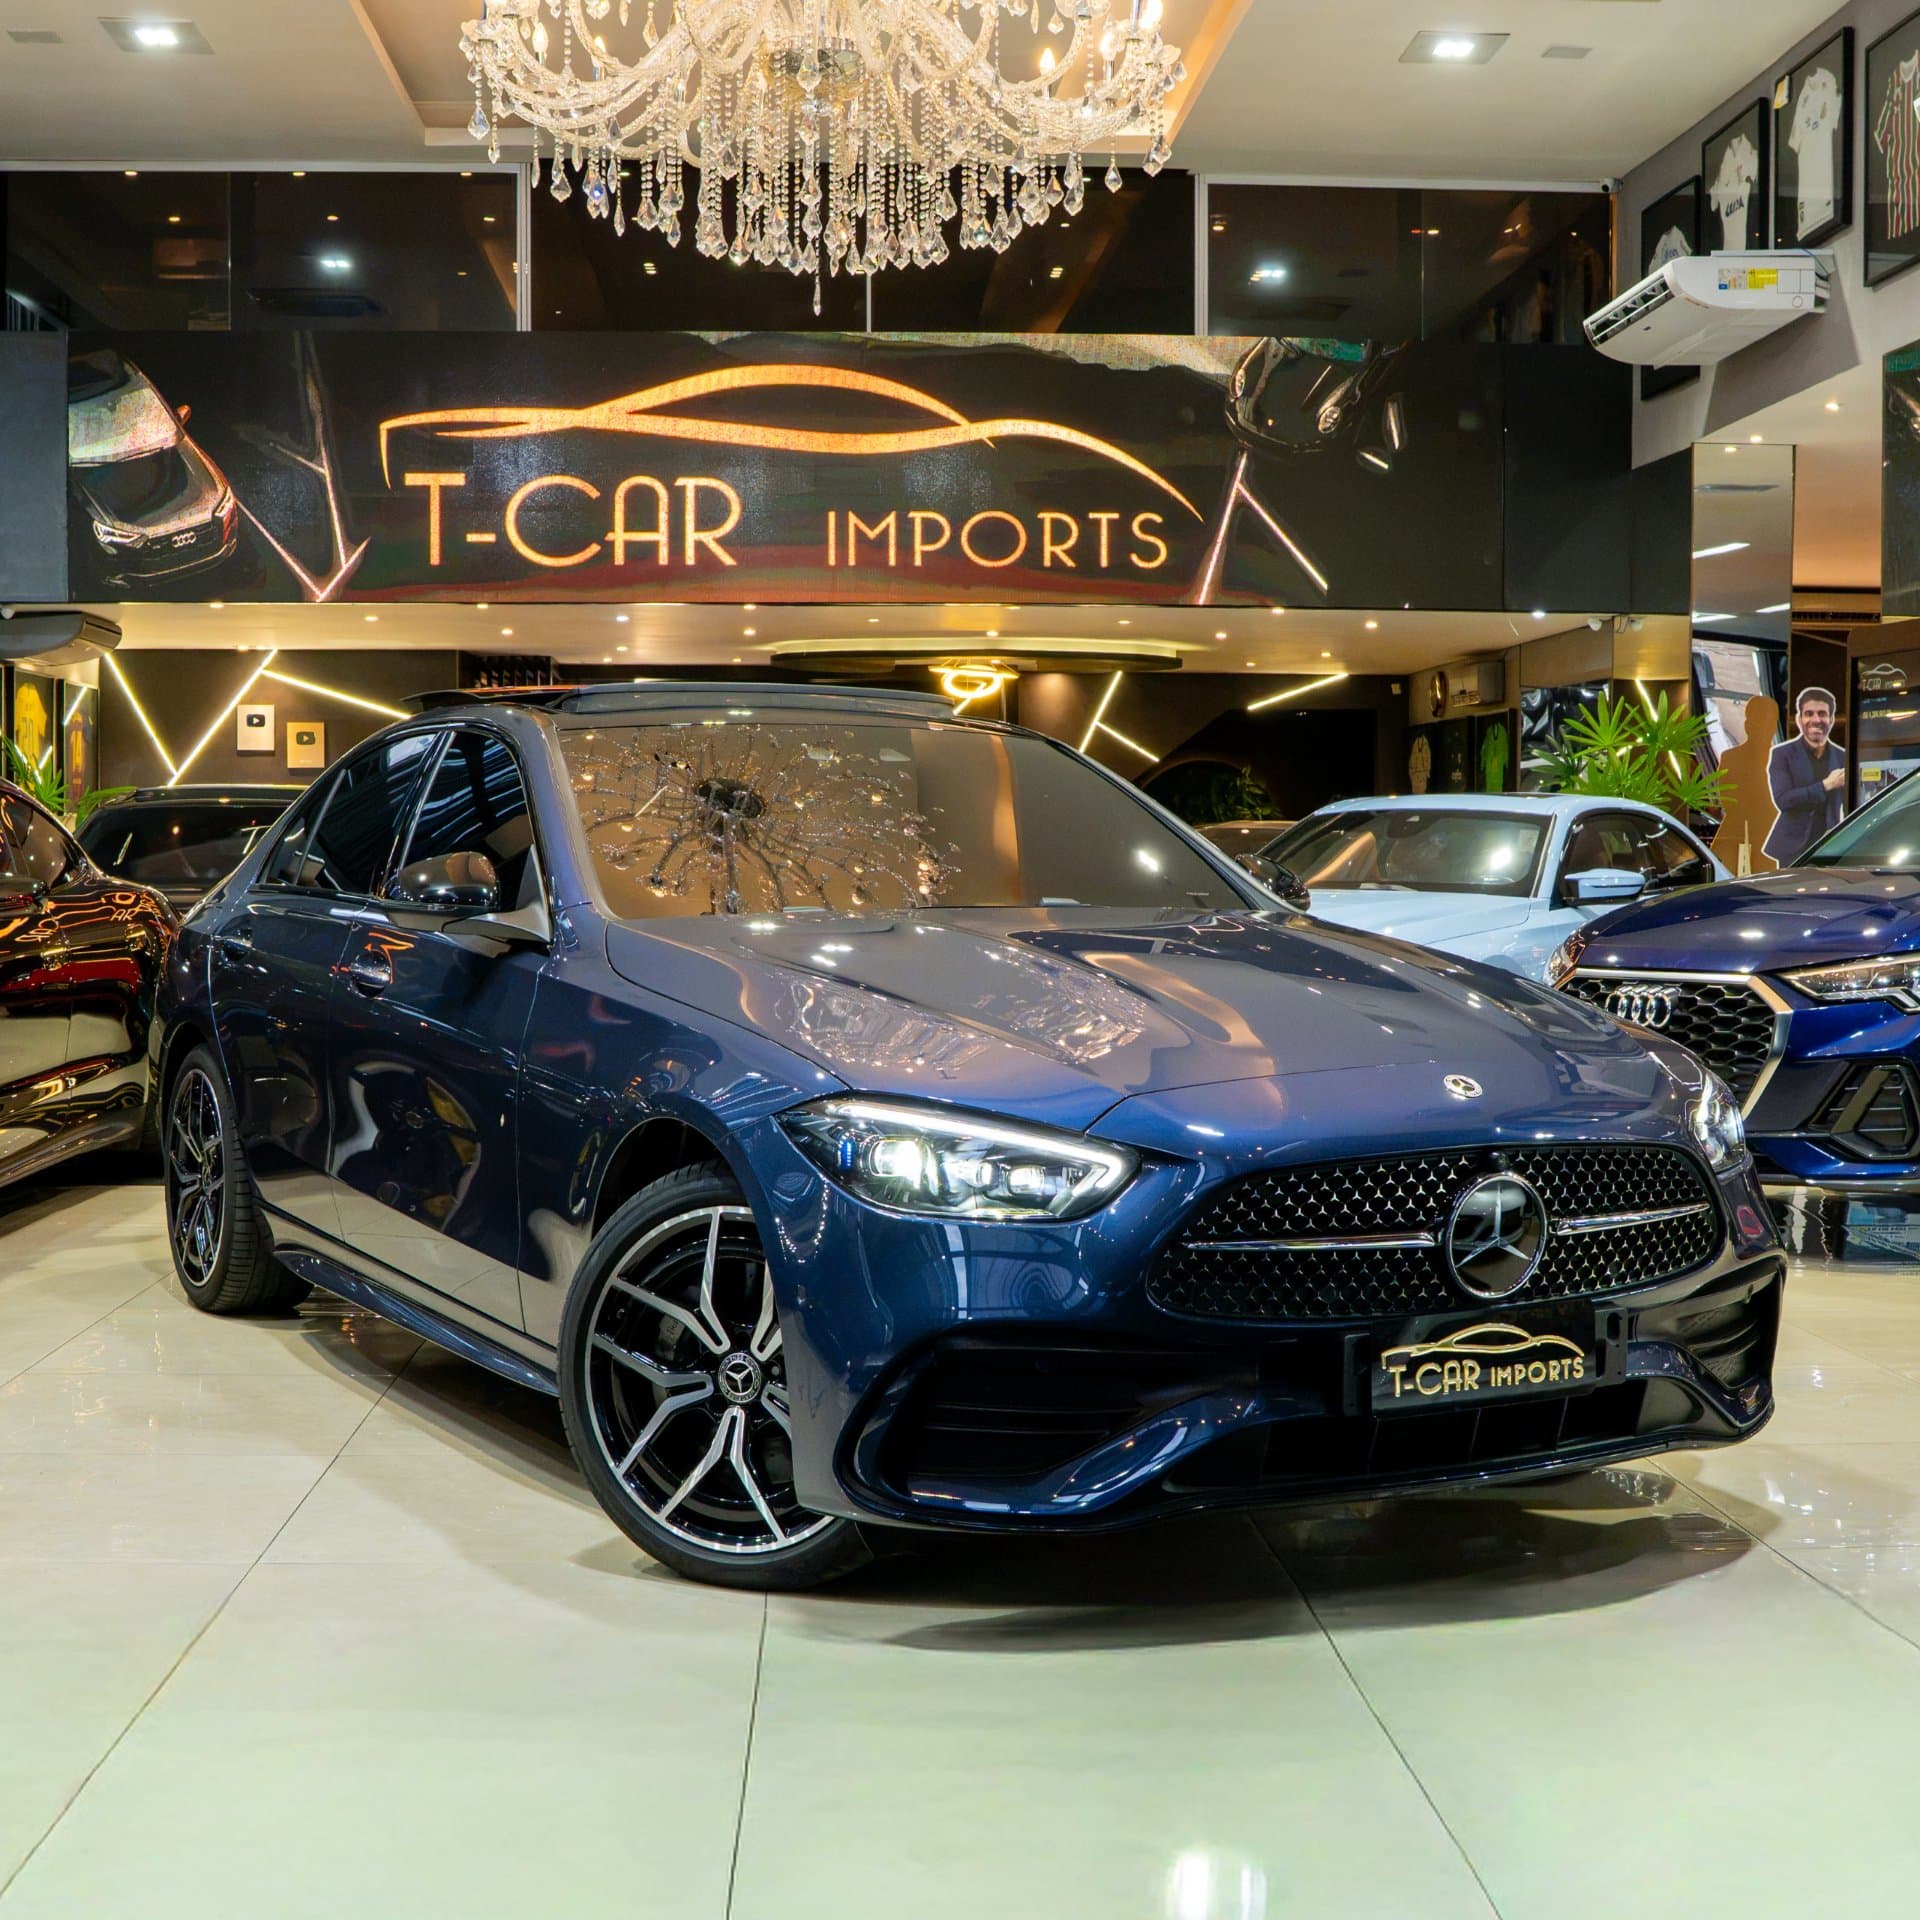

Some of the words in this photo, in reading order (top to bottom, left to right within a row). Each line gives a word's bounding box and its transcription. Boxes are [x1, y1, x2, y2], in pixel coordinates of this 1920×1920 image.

[404, 472, 742, 567] T-CAR
[827, 509, 1168, 569] IMPORTS
[1387, 1359, 1481, 1397] T-CAR
[1490, 1356, 1585, 1387] IMPORTS
